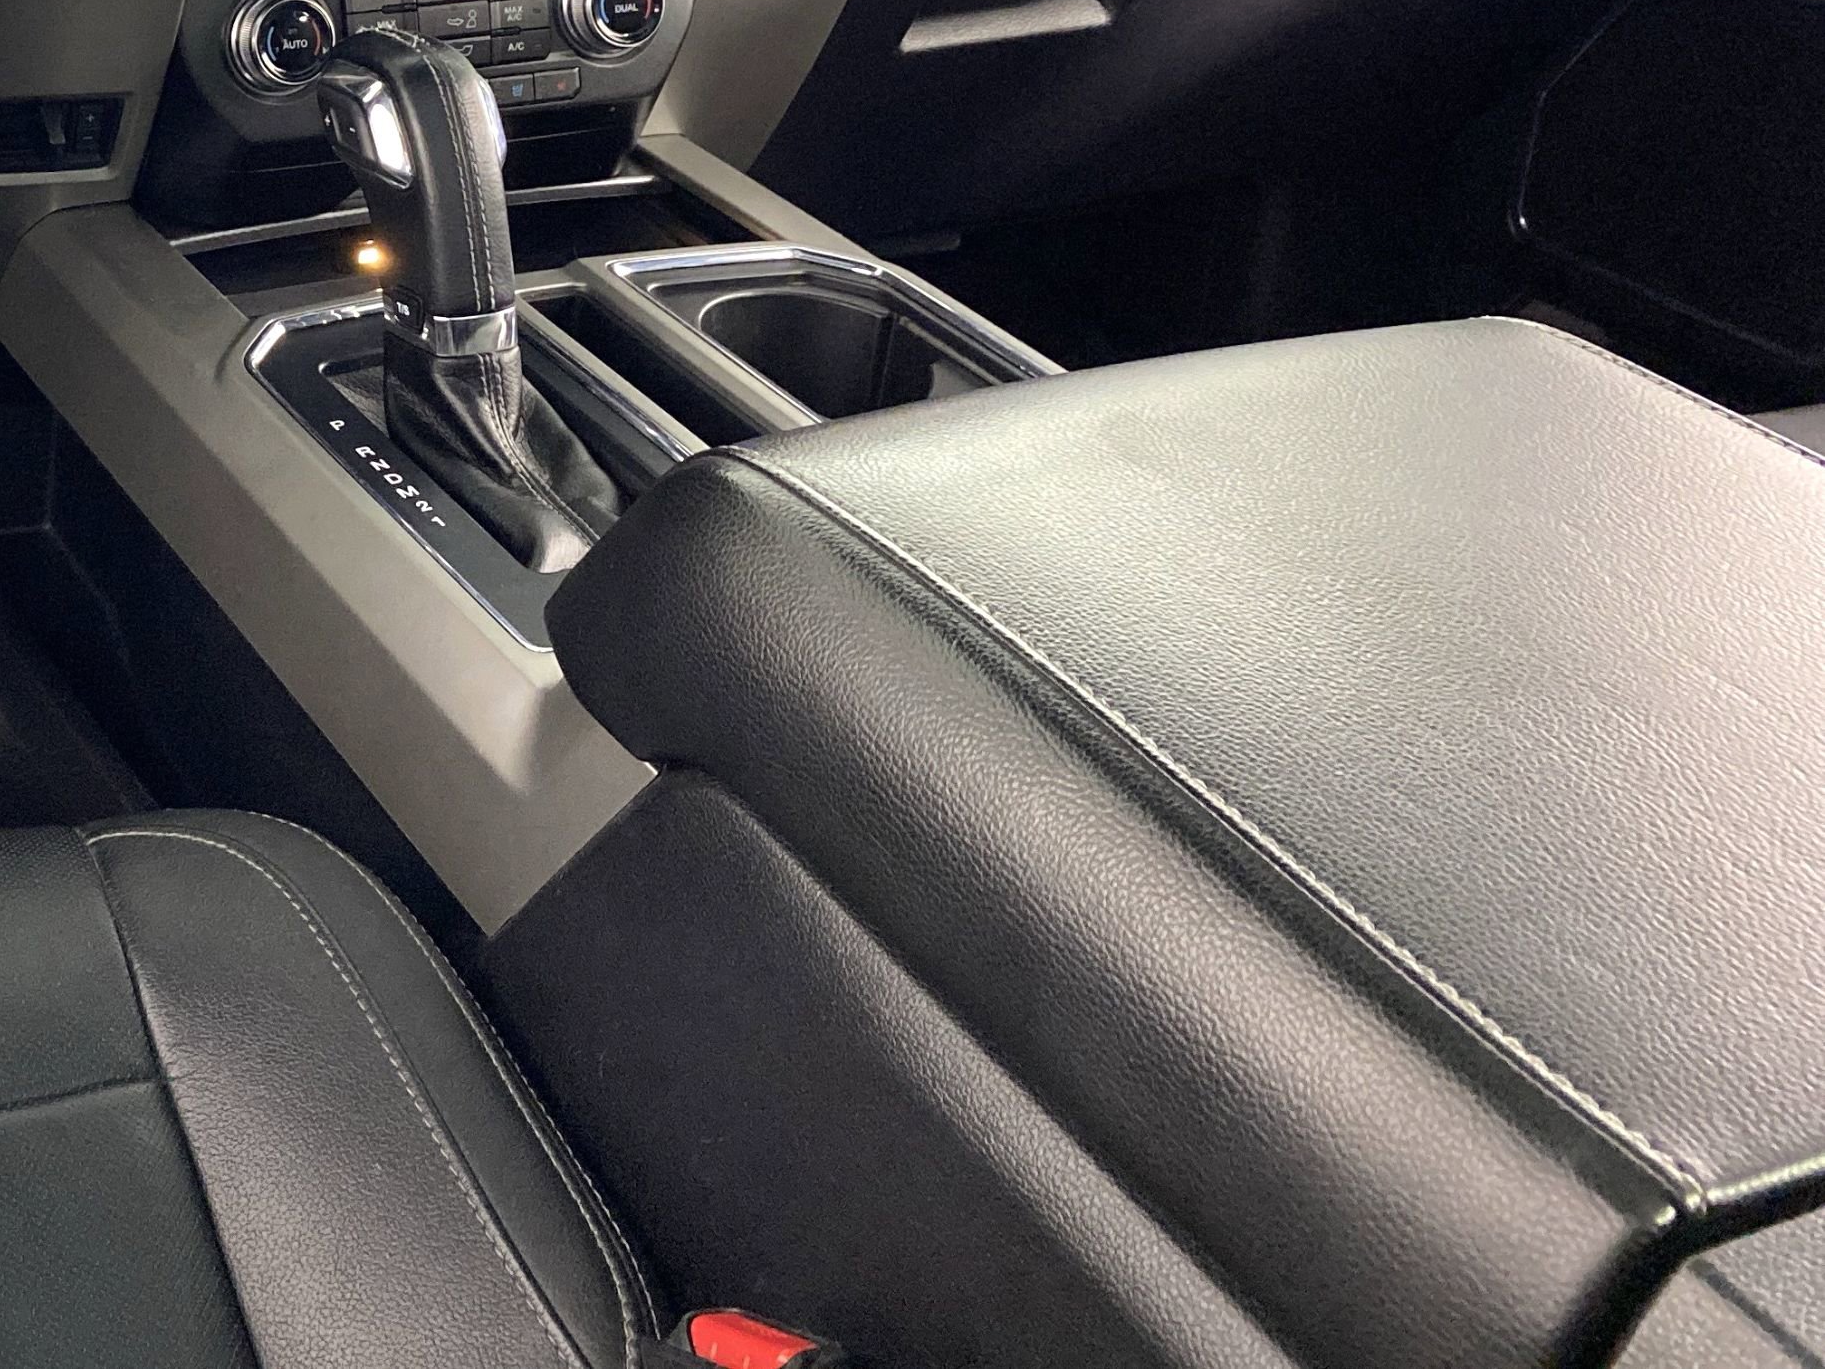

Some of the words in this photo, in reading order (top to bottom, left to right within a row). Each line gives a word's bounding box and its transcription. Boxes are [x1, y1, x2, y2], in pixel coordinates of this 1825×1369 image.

[504, 6, 524, 14] MAX
[614, 3, 639, 14] DUAL
[507, 13, 522, 22] A/C
[282, 38, 308, 50] AUTO
[507, 42, 524, 52] A/C
